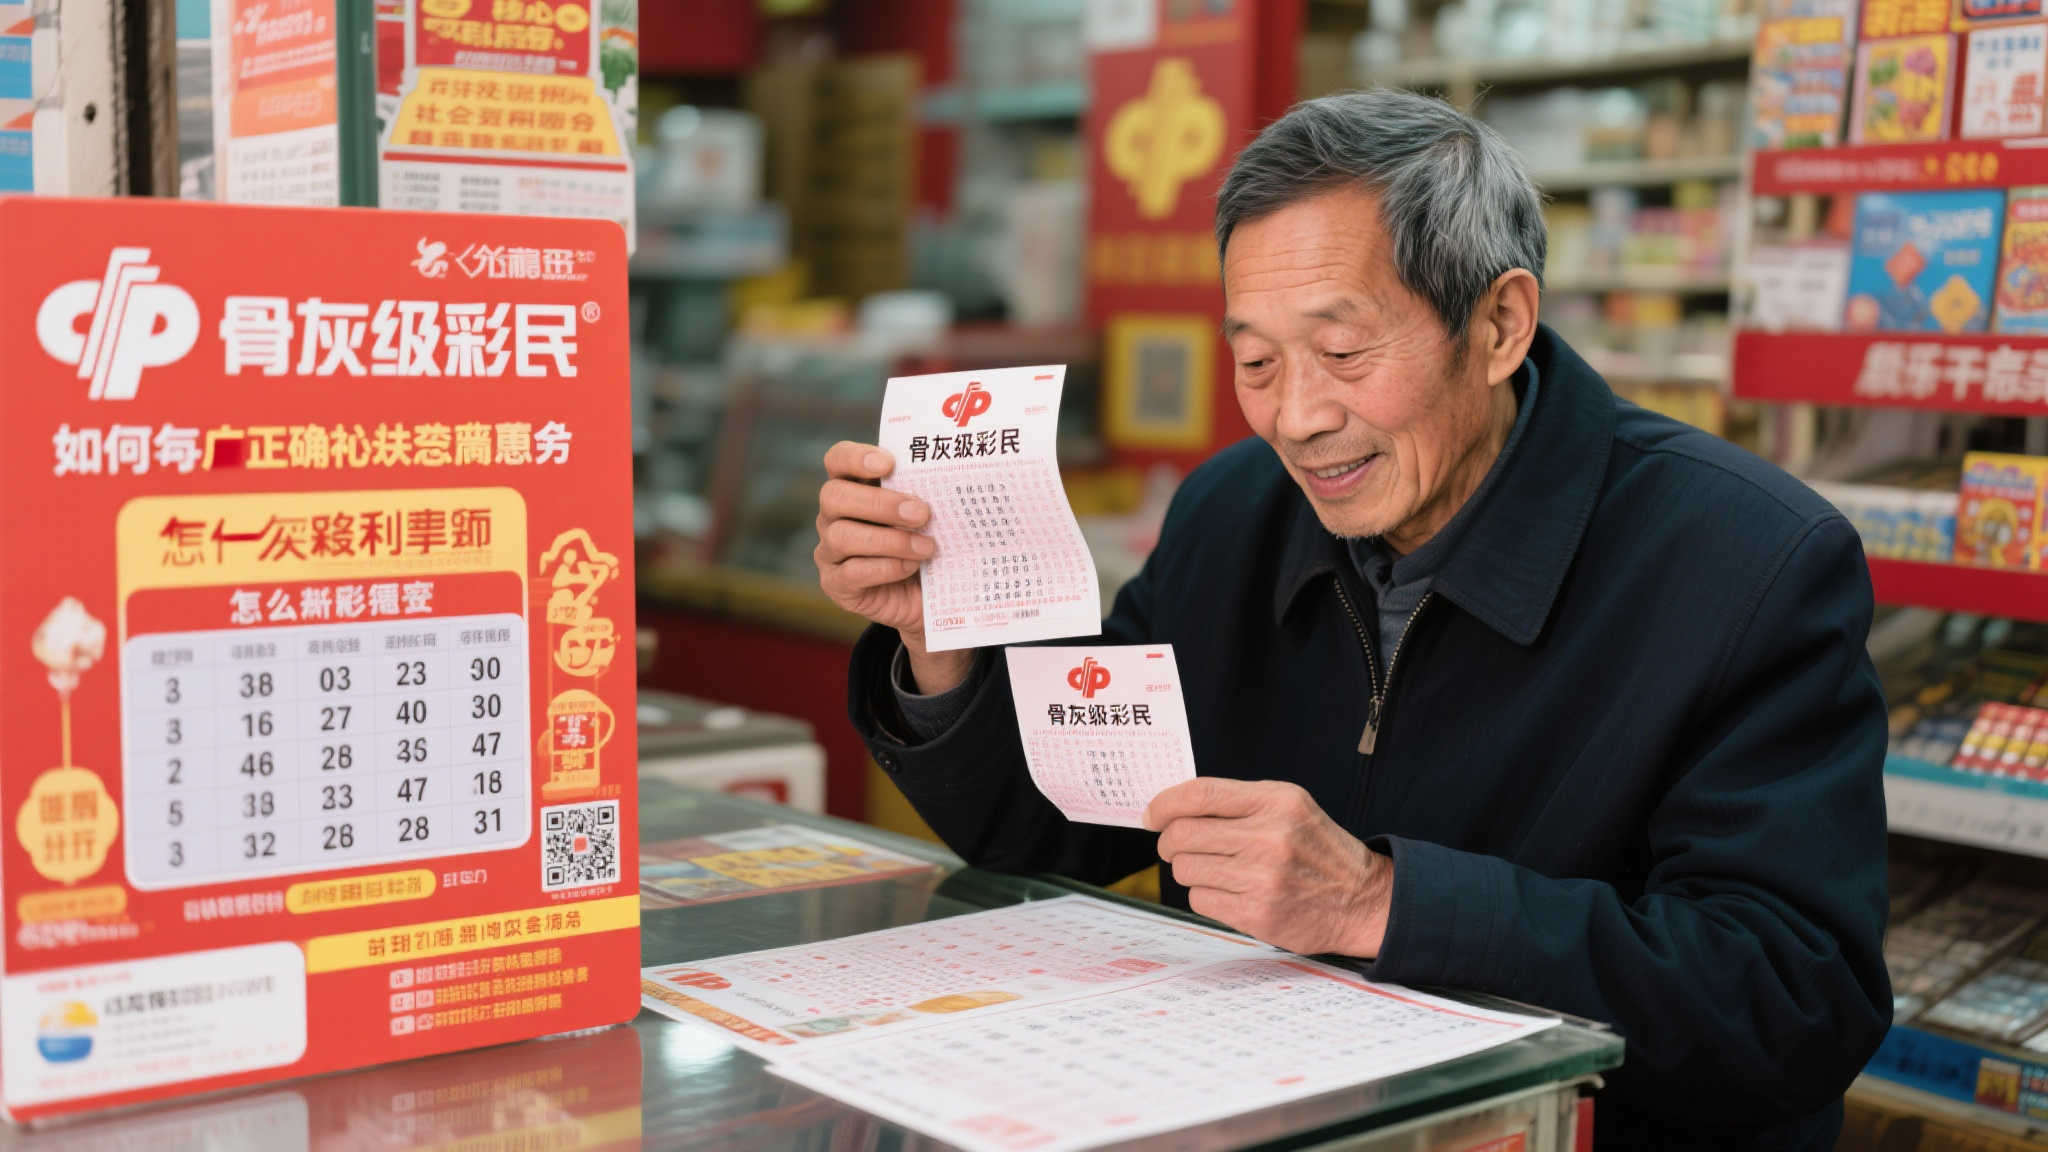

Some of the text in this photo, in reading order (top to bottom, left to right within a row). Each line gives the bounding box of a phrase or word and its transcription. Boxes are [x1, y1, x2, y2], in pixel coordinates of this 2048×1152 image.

[219, 295, 578, 377] 骨灰级彩民
[909, 428, 1021, 463] 骨灰级彩民
[166, 656, 501, 704] 3 38 03 23 30
[166, 694, 502, 744] 3 16 27 40 30
[1048, 703, 1152, 726] 骨灰级彩民
[167, 759, 182, 784] 2
[240, 751, 274, 777] 46
[472, 731, 502, 757] 47
[167, 800, 183, 826] 5
[397, 777, 428, 802] 47
[168, 841, 184, 867] 3
[243, 832, 276, 858] 32
[399, 816, 430, 842] 28
[474, 808, 501, 834] 31
